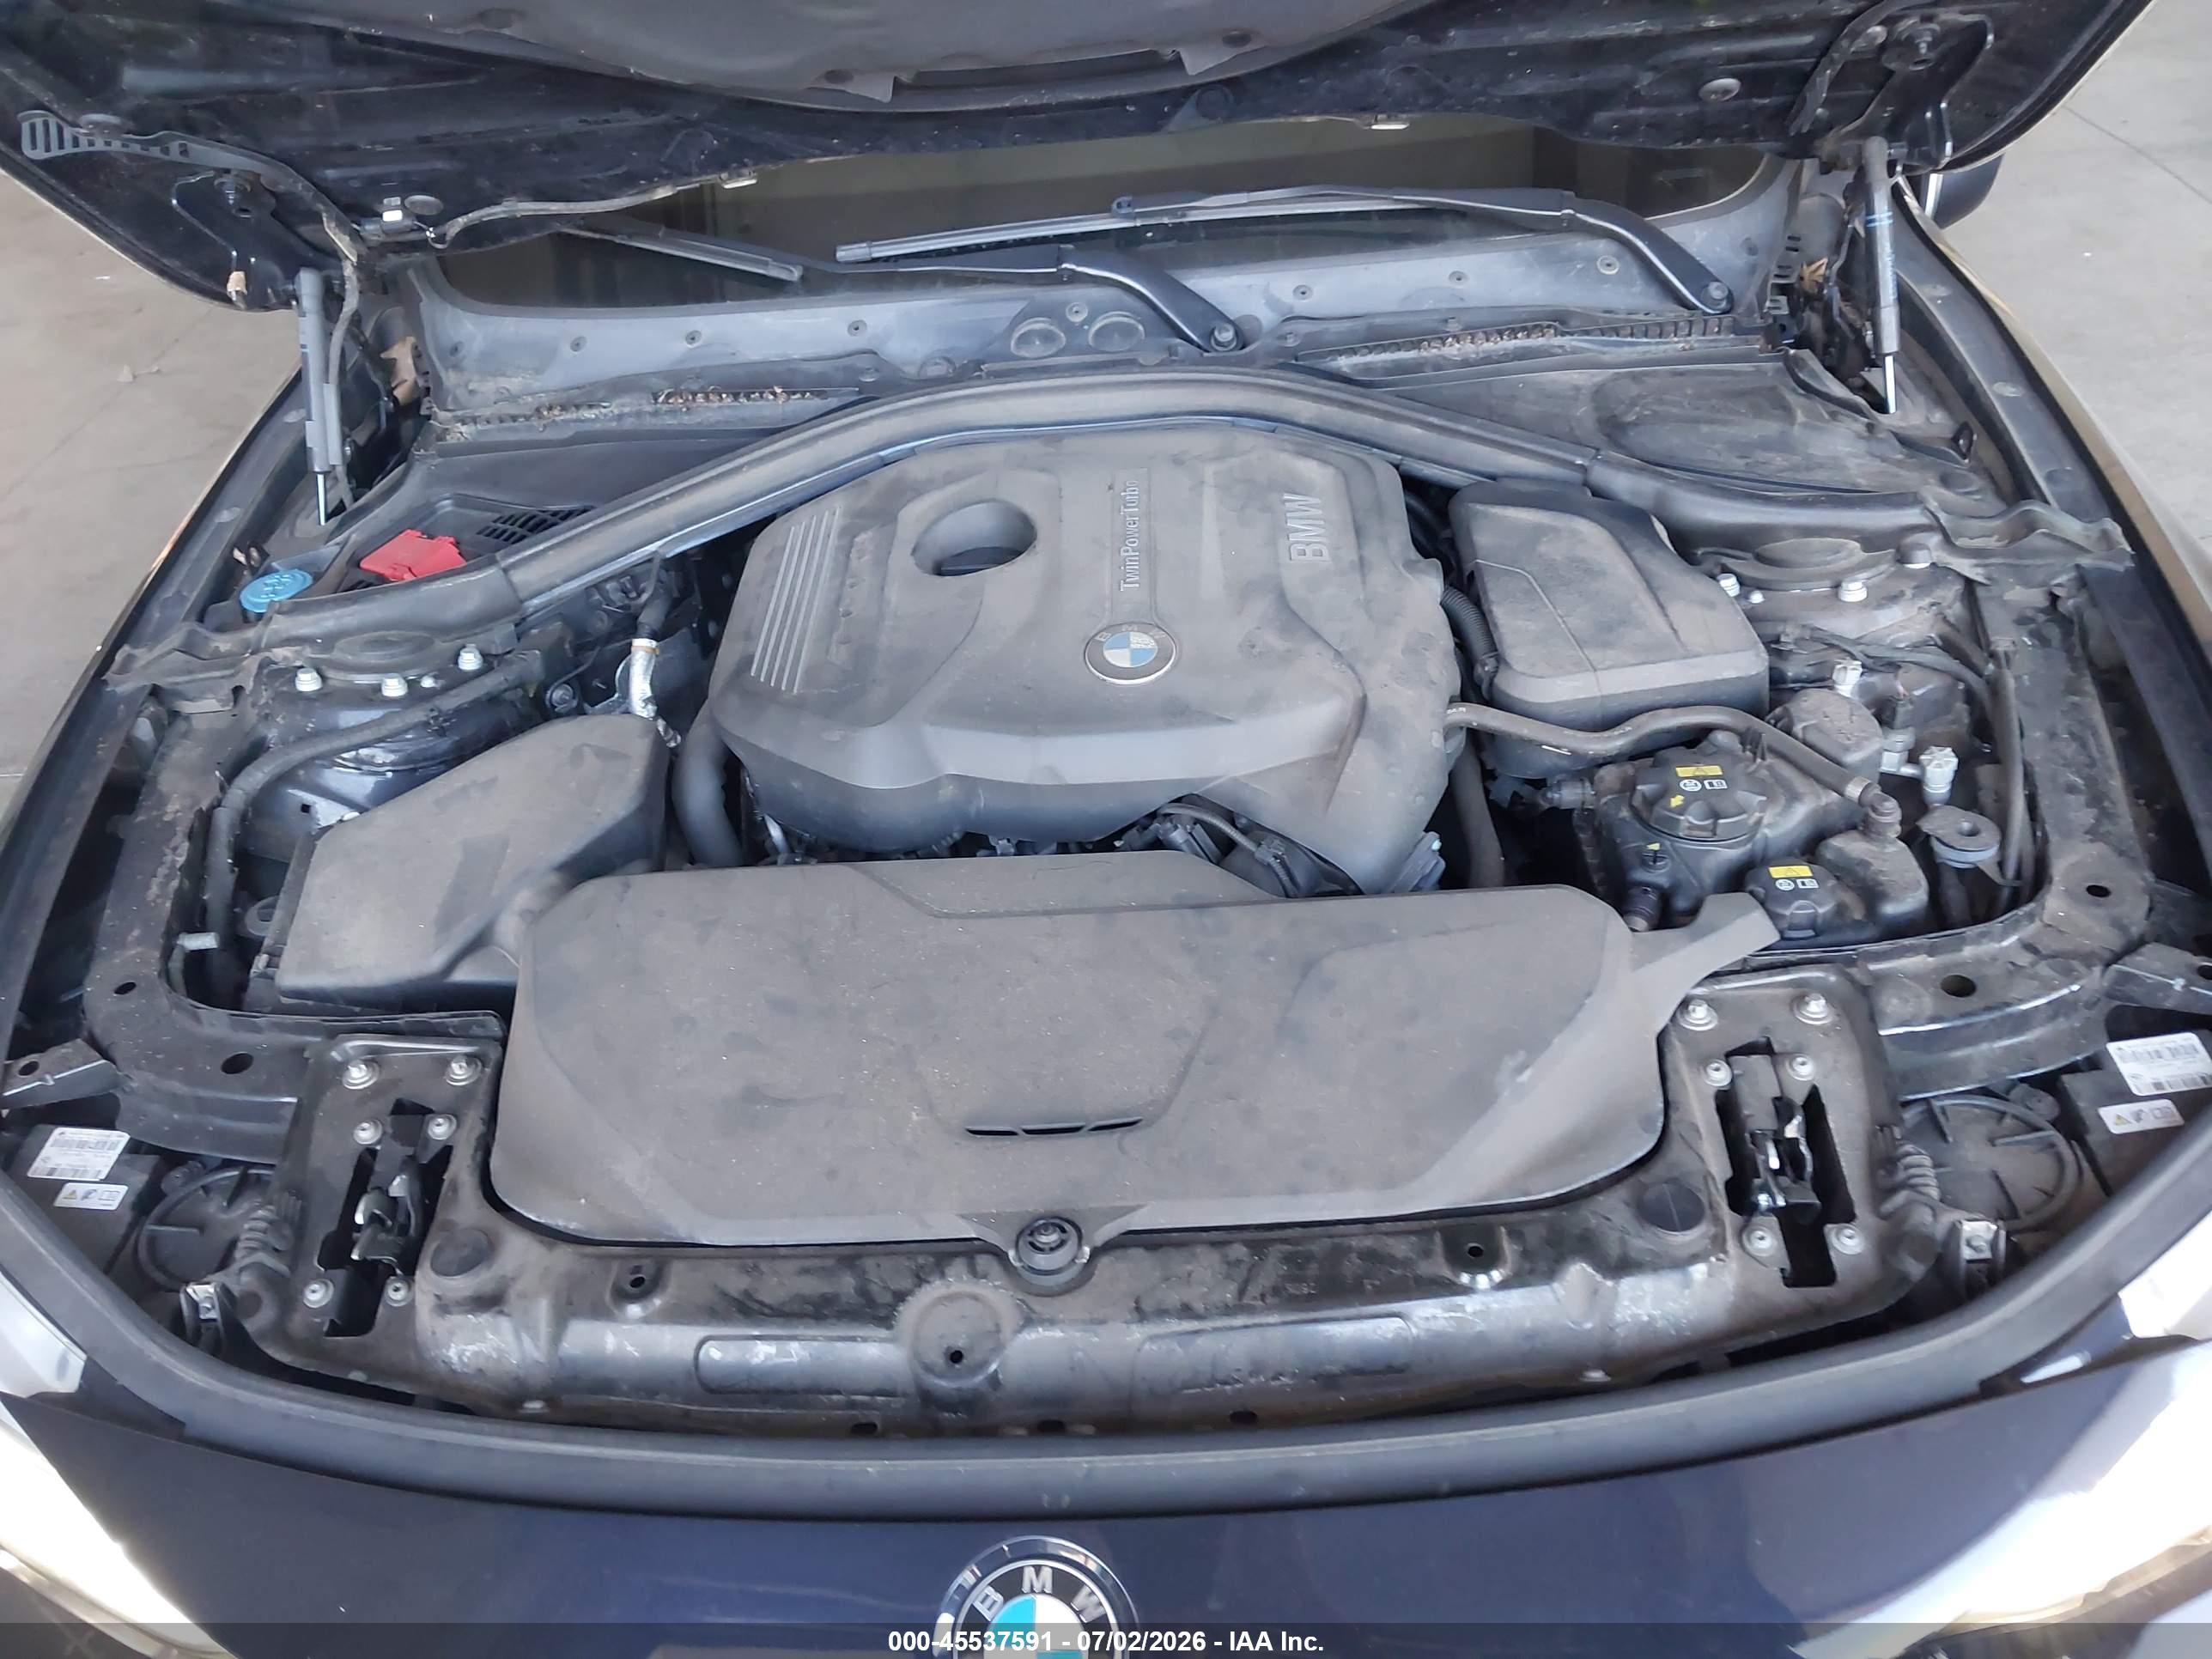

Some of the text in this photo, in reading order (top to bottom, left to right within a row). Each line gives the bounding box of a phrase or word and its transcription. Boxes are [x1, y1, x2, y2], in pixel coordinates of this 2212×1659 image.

[1120, 480, 1140, 592] TwinPowerTurbo
[1283, 492, 1330, 562] BMW
[1094, 624, 1167, 642] BMW
[972, 1565, 1108, 1623] BMW
